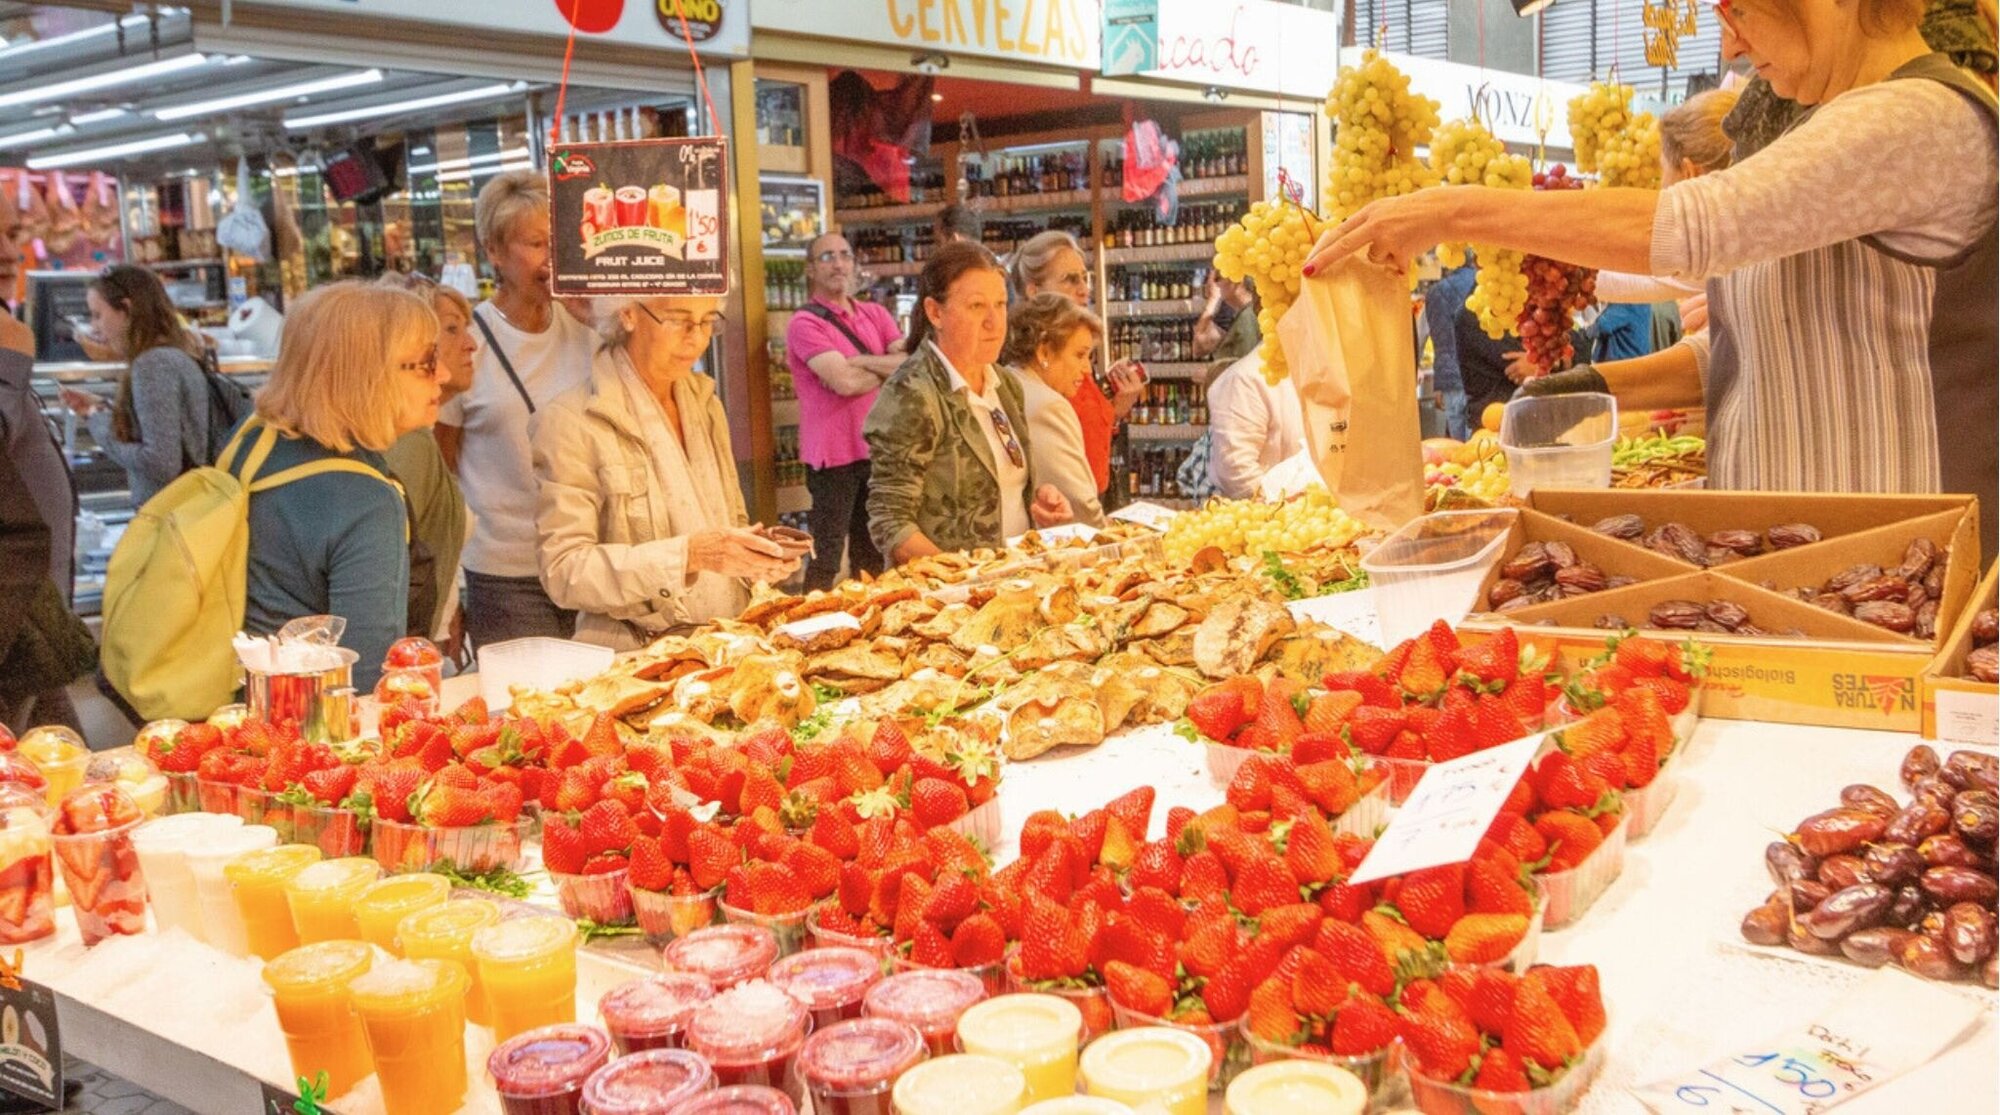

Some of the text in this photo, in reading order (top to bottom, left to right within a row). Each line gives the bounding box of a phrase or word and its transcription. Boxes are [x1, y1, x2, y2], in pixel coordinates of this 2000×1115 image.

[886, 0, 1087, 61] CERVEZAS
[593, 228, 674, 247] ZUMOS DE FRUTA
[595, 256, 665, 267] FRUIT JUICE
